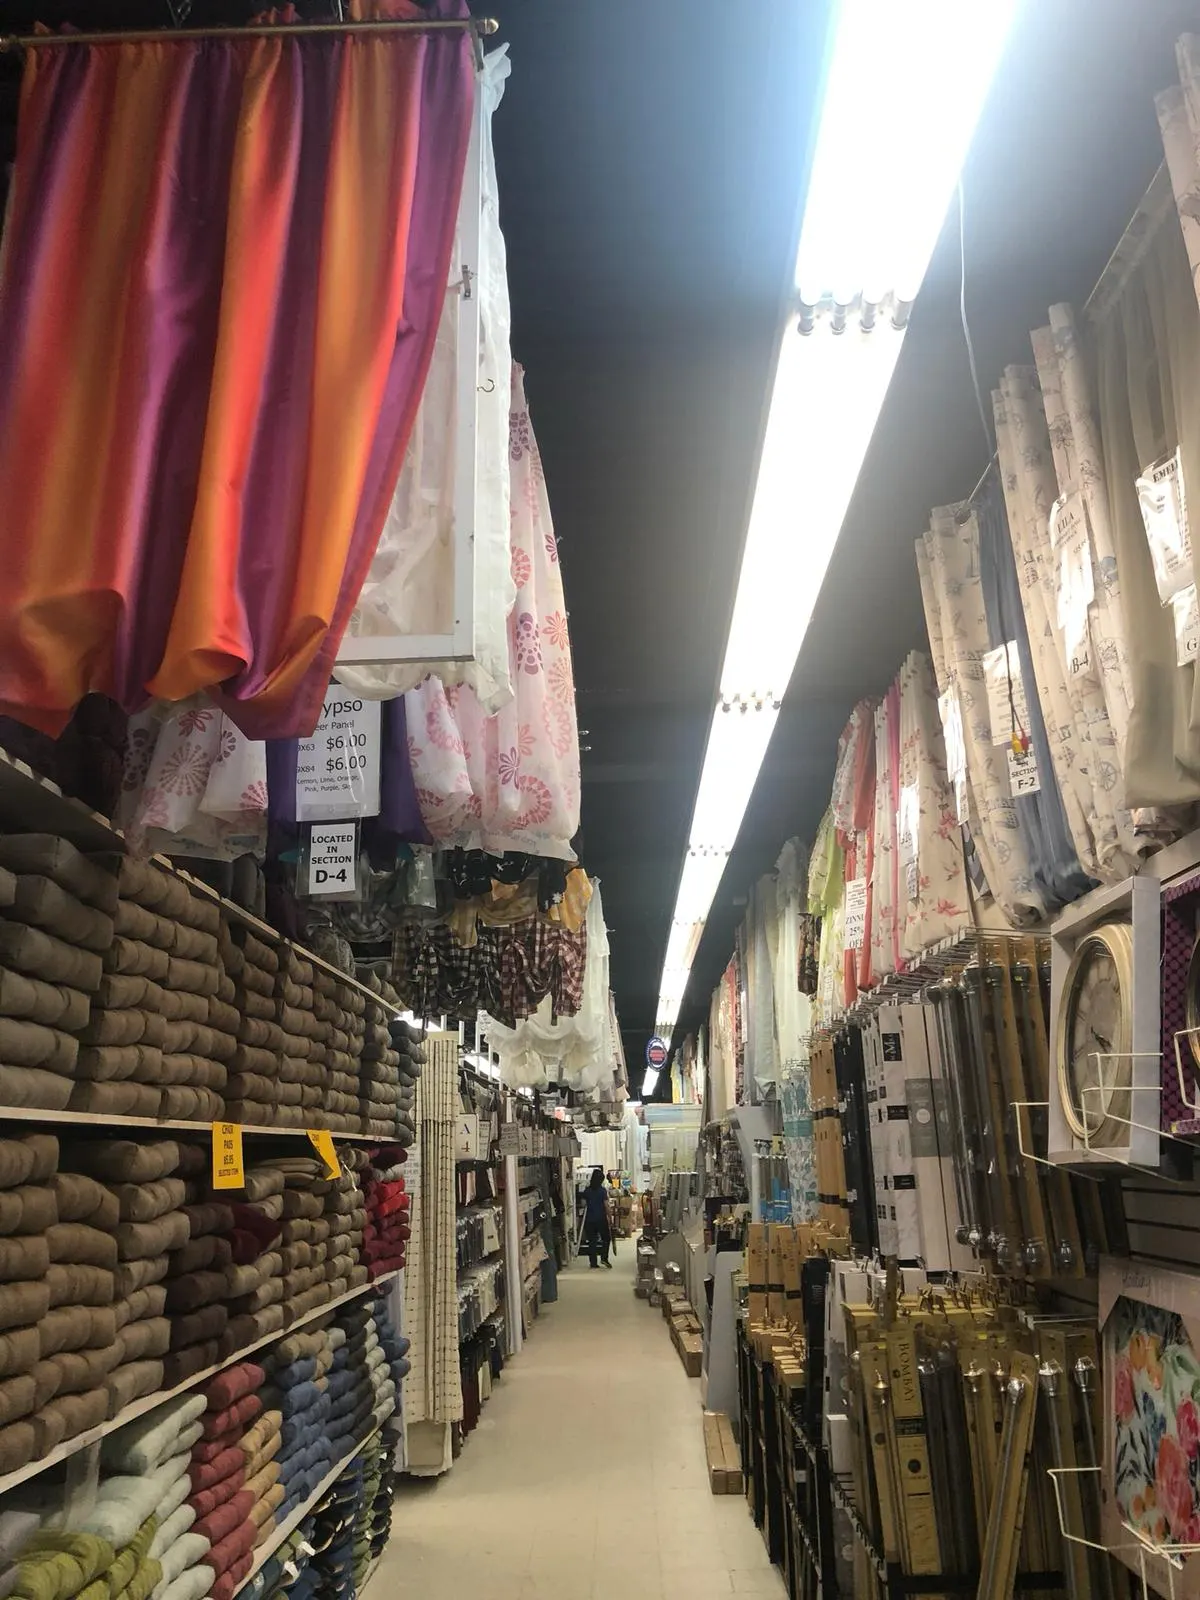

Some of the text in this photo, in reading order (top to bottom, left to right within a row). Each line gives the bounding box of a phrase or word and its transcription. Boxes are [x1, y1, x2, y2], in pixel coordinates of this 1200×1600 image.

[1072, 651, 1089, 673] B-4
[331, 720, 354, 730] Panel
[326, 733, 366, 751] $6.00
[326, 755, 366, 773] $6.00
[1018, 777, 1035, 789] F-2
[312, 835, 353, 843] LOCATED
[312, 856, 352, 864] SECTION
[315, 869, 347, 883] D-4
[460, 1123, 471, 1134] A
[461, 1141, 470, 1152] 4
